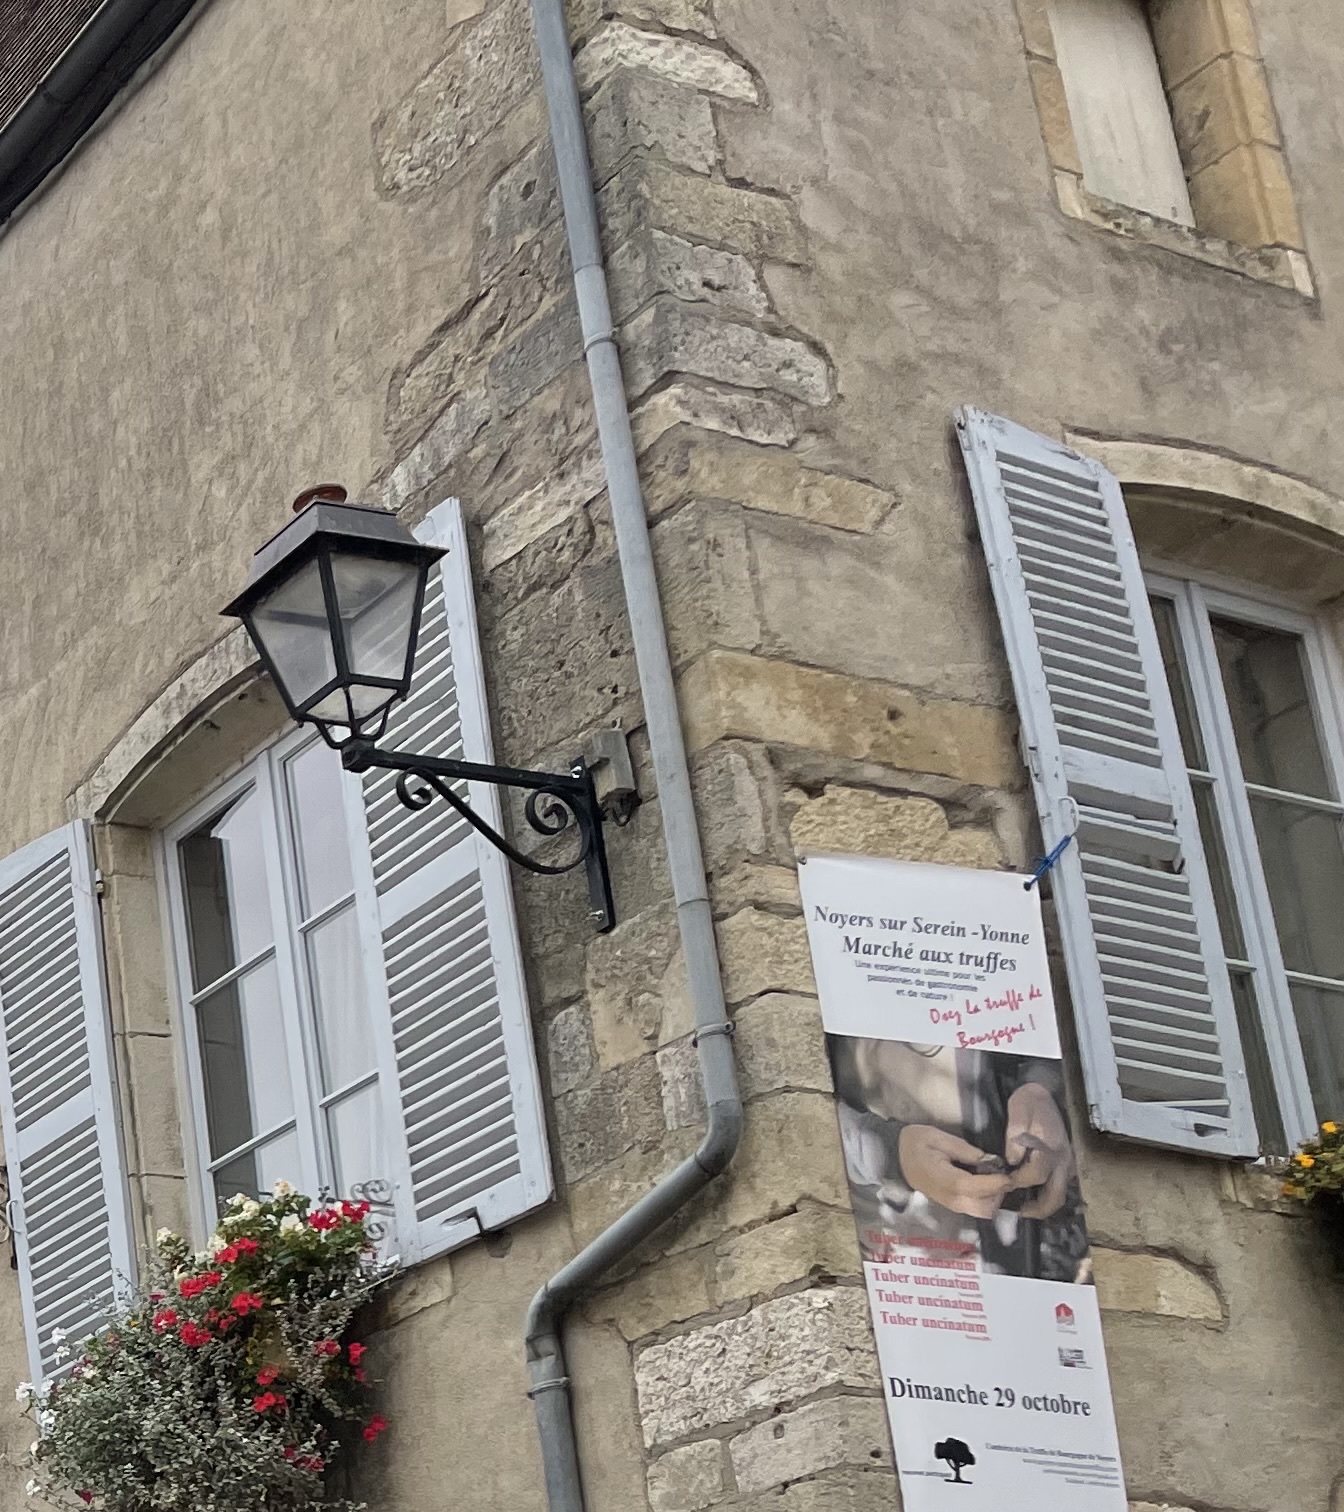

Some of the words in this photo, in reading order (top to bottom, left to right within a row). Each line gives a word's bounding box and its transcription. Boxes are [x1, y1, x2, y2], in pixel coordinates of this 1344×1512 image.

[814, 905, 874, 929] Noyers
[880, 917, 907, 931] sur
[912, 916, 967, 938] Serein
[842, 935, 913, 960] Marché
[919, 948, 953, 965] aux
[959, 951, 1017, 974] truffes
[872, 1268, 910, 1284] Tuber
[913, 1274, 980, 1291] uncinatum
[875, 1289, 914, 1305] Tuber
[917, 1295, 984, 1312] uncinatum
[880, 1311, 918, 1326] Tuber
[921, 1317, 987, 1333] uncinatum
[888, 1377, 989, 1407] Dimanche
[994, 1387, 1016, 1408] 29
[1022, 1394, 1091, 1416] octobre
